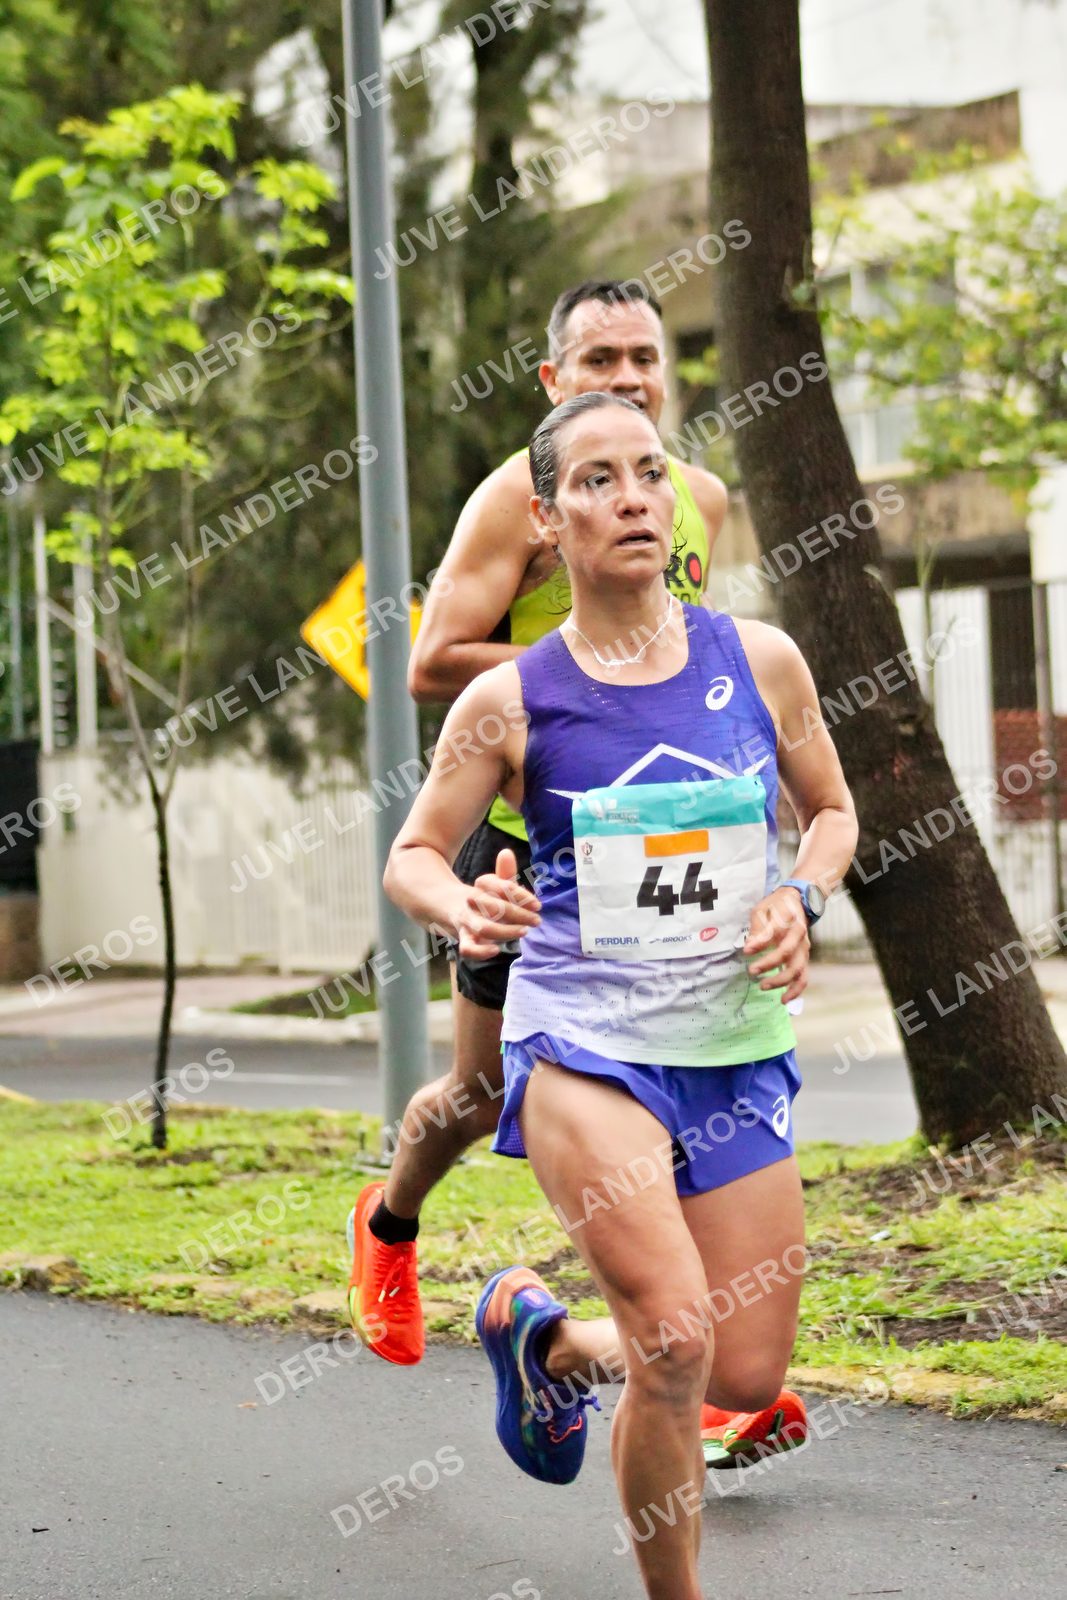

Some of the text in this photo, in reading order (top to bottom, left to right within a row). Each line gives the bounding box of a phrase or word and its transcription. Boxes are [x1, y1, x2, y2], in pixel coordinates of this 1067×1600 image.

[637, 861, 718, 916] 44
[594, 936, 640, 946] PERDURA
[662, 934, 693, 943] BROOKS
